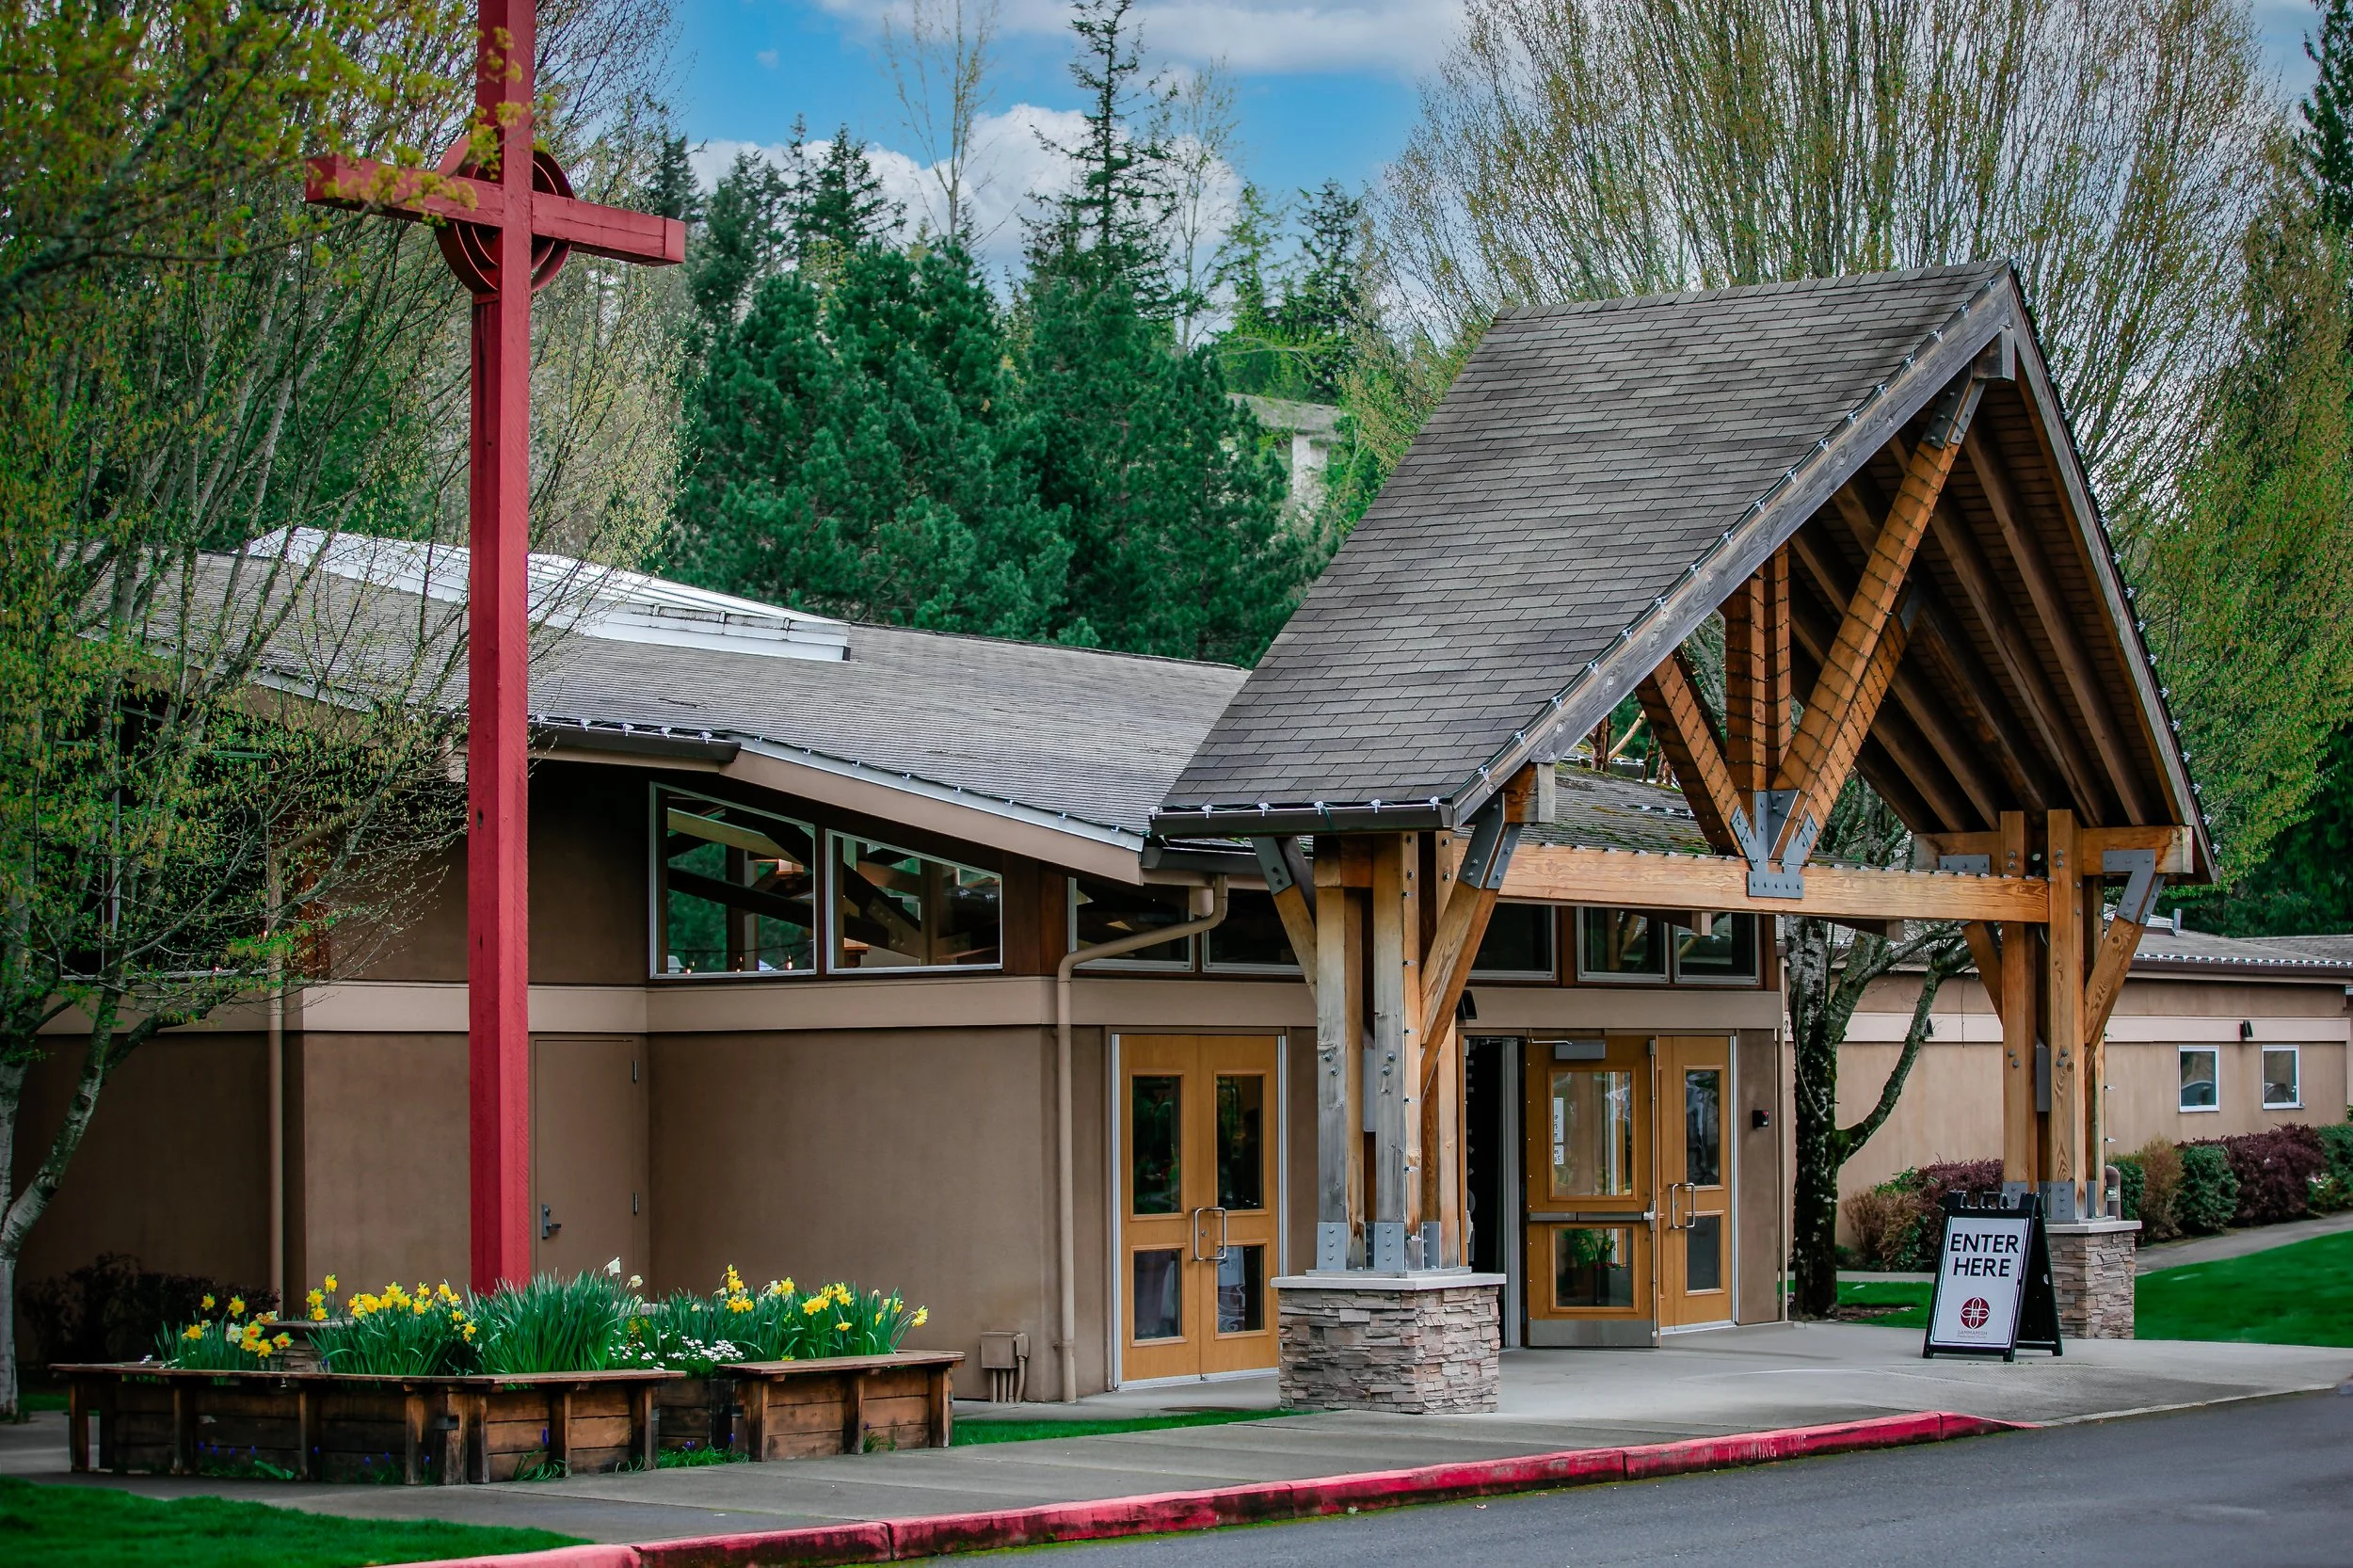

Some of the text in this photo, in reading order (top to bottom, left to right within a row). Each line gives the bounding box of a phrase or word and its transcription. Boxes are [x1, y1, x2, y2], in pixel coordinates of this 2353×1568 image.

[1950, 1233, 2019, 1253] ENTER
[1953, 1257, 2010, 1277] HERE
[1728, 1438, 1777, 1462] PRKING
